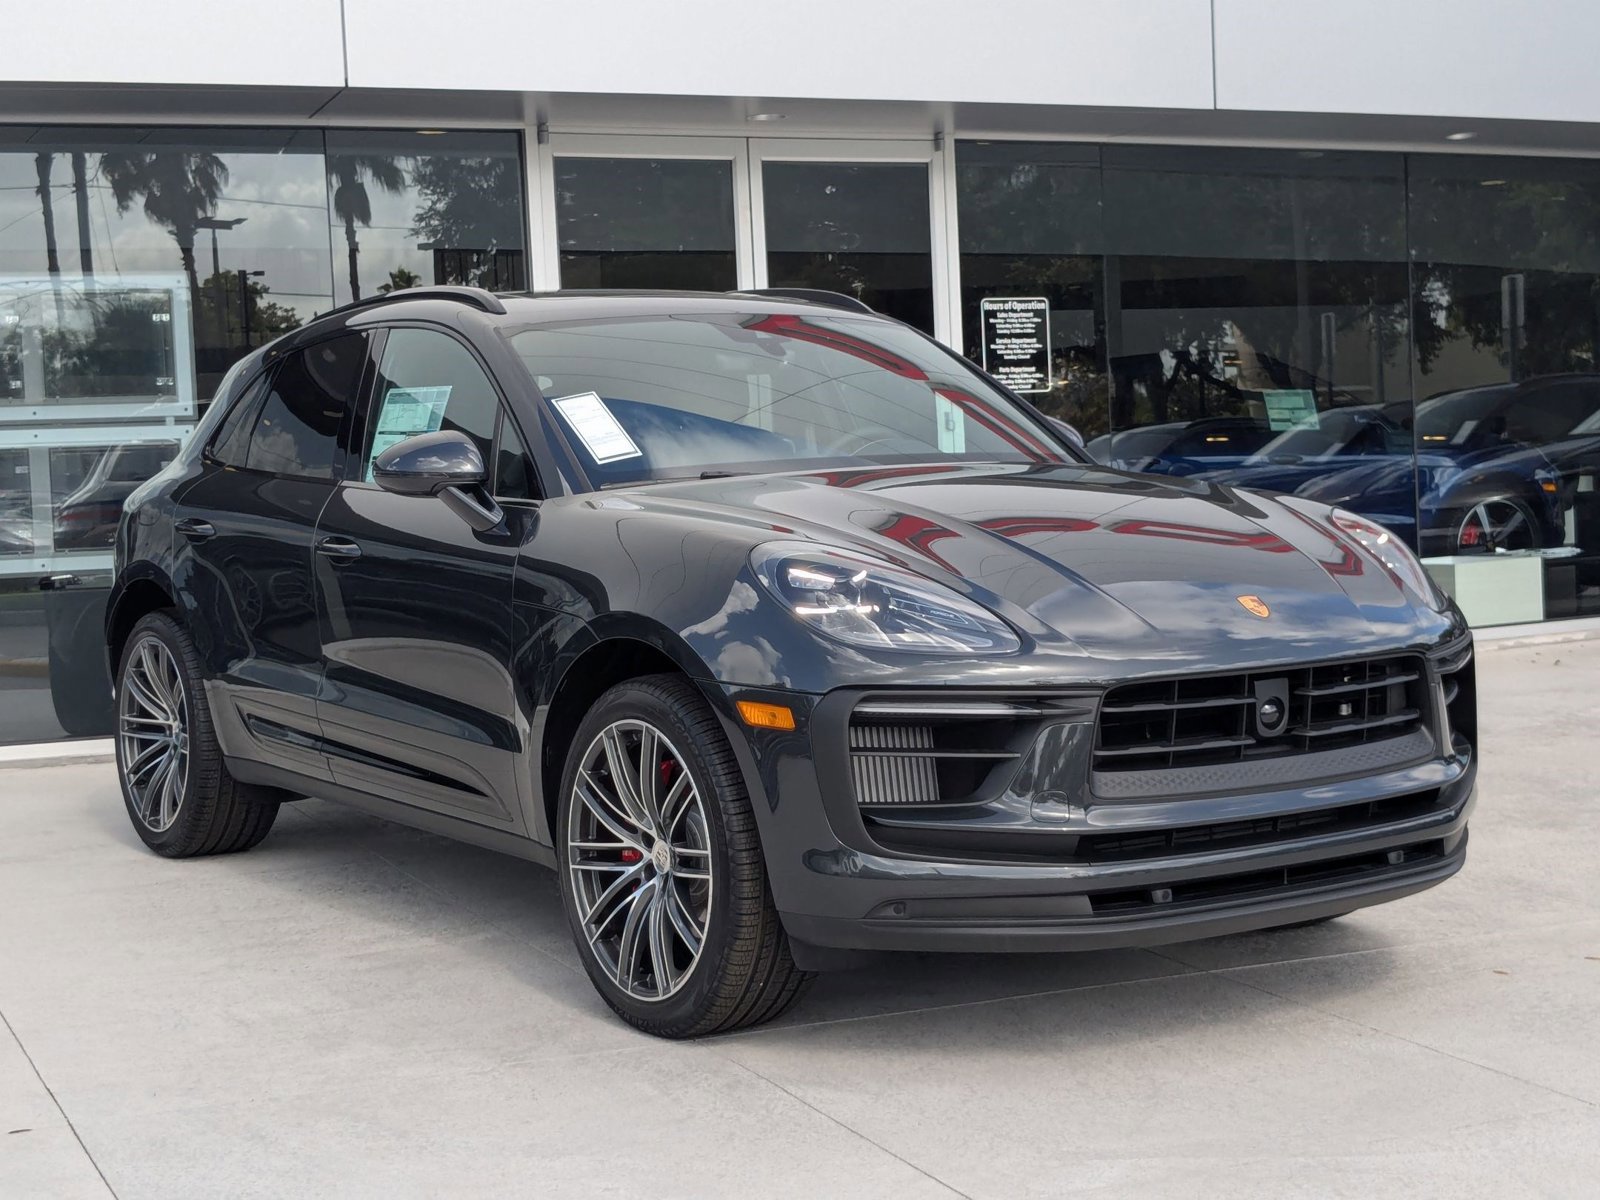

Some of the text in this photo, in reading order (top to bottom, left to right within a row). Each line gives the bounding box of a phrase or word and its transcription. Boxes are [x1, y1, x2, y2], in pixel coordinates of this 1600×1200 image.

[984, 301, 1045, 312] Hours of Operation
